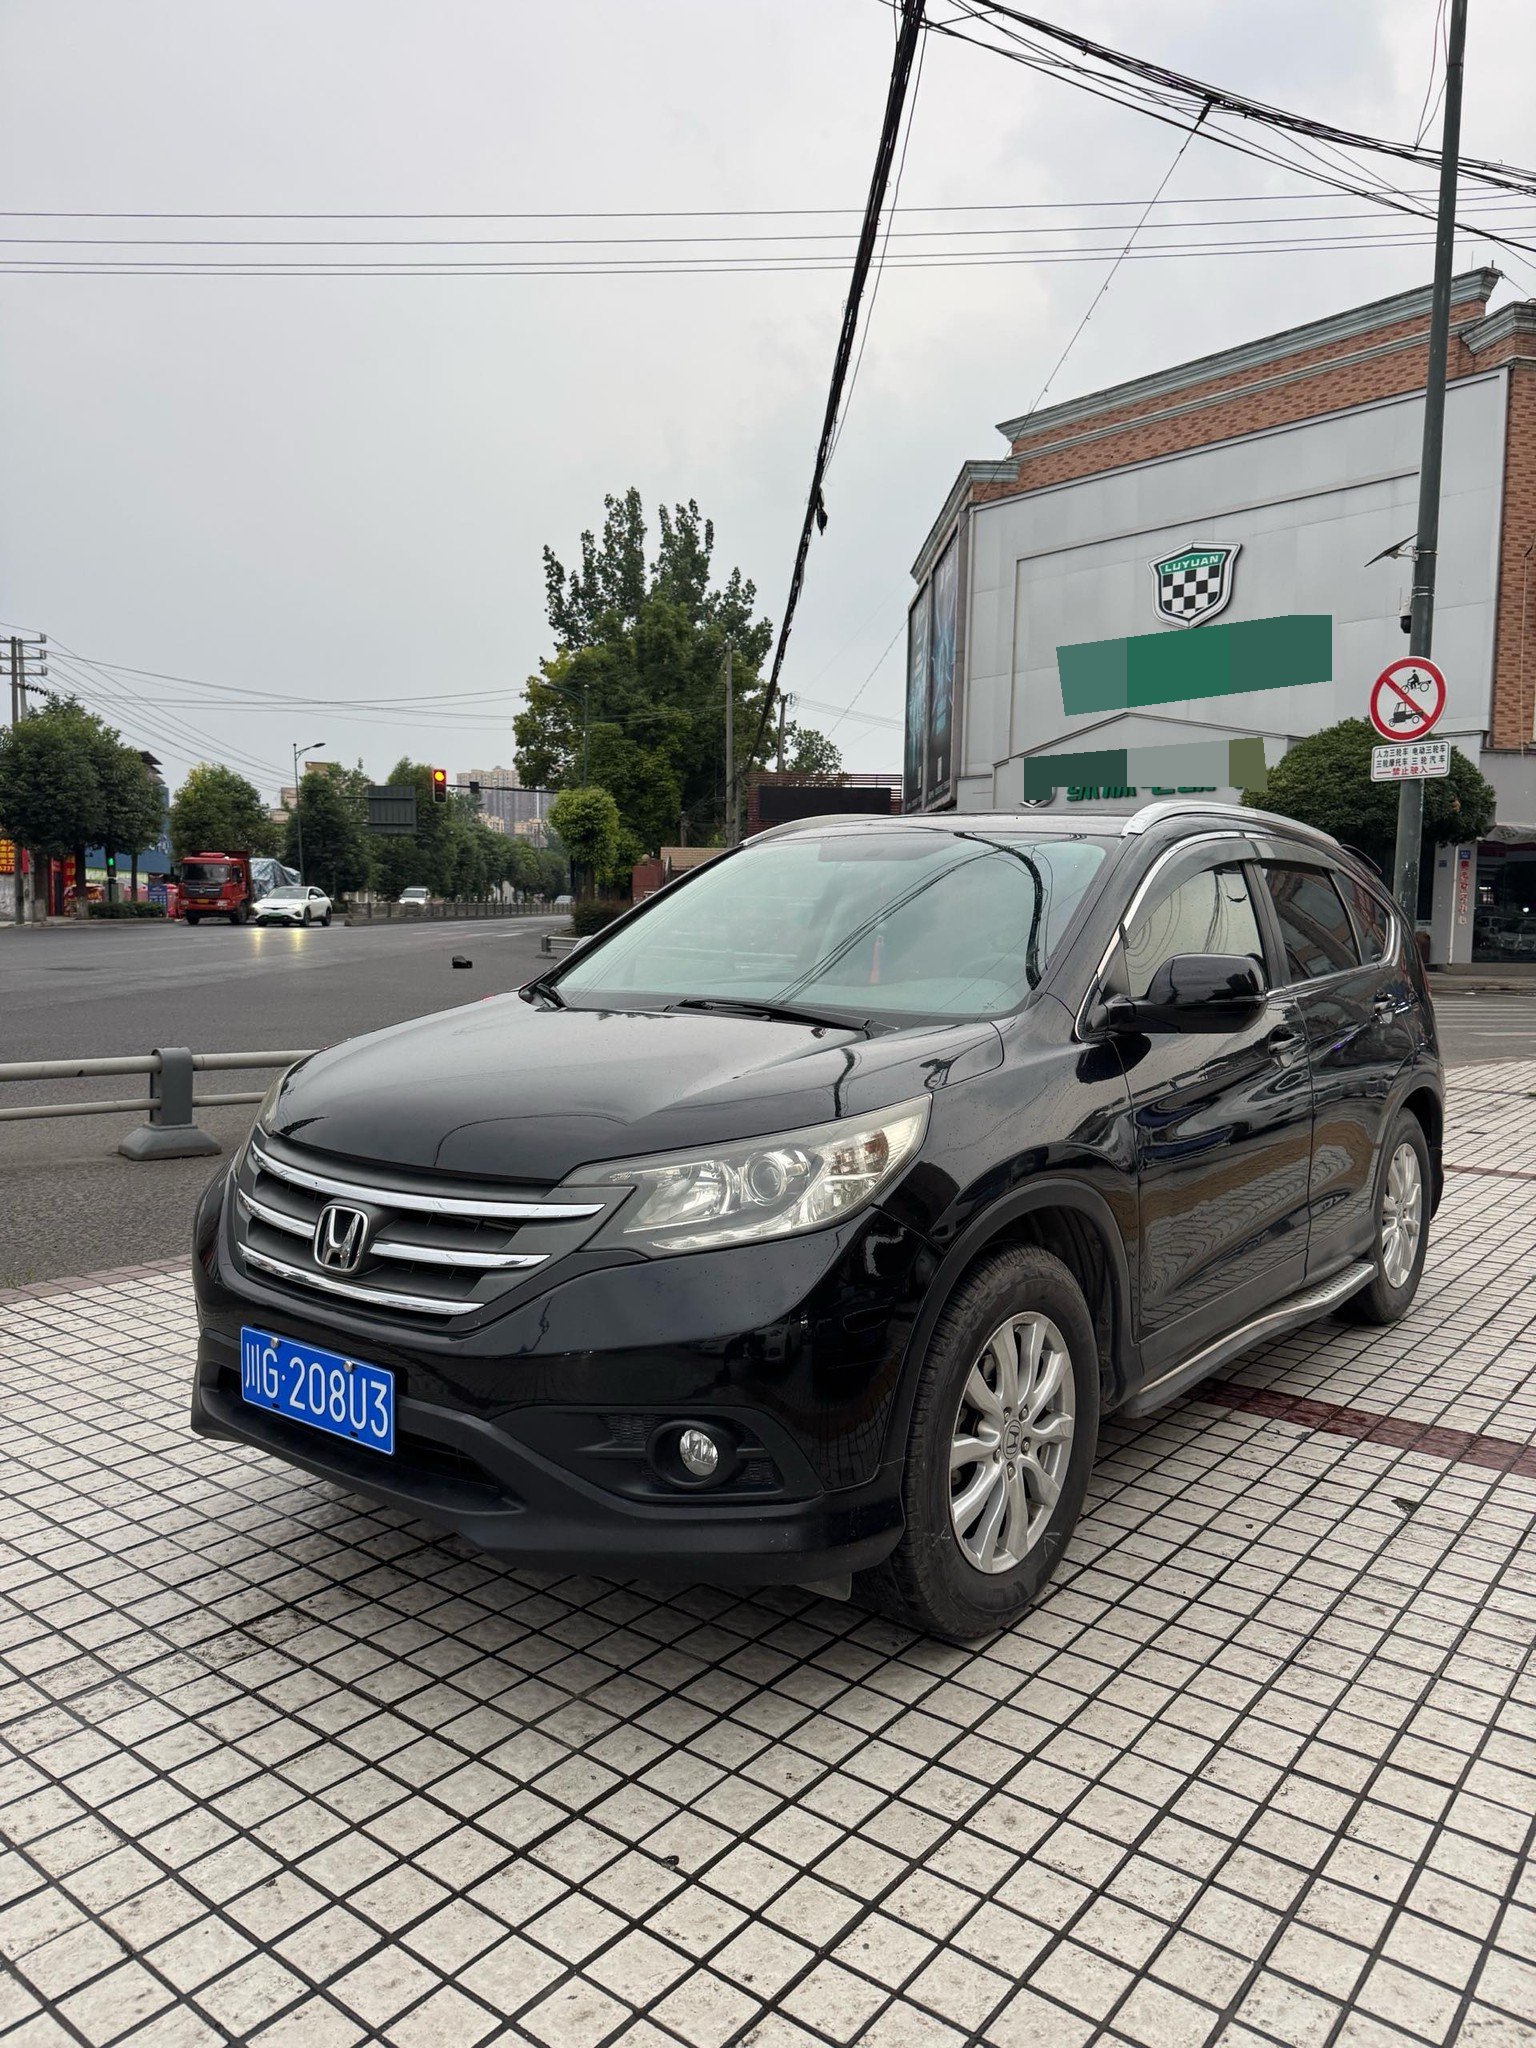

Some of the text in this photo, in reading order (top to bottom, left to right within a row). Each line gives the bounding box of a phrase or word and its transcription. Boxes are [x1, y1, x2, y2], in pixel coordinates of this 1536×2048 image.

[1164, 555, 1219, 572] LUYUAN
[1376, 745, 1446, 758] 人力三轮车 电动三轮车
[1376, 755, 1445, 768] 三轮摩托车 三轮汽车
[1392, 766, 1428, 776] 禁止驶入
[245, 1342, 389, 1438] 川G·208U3
